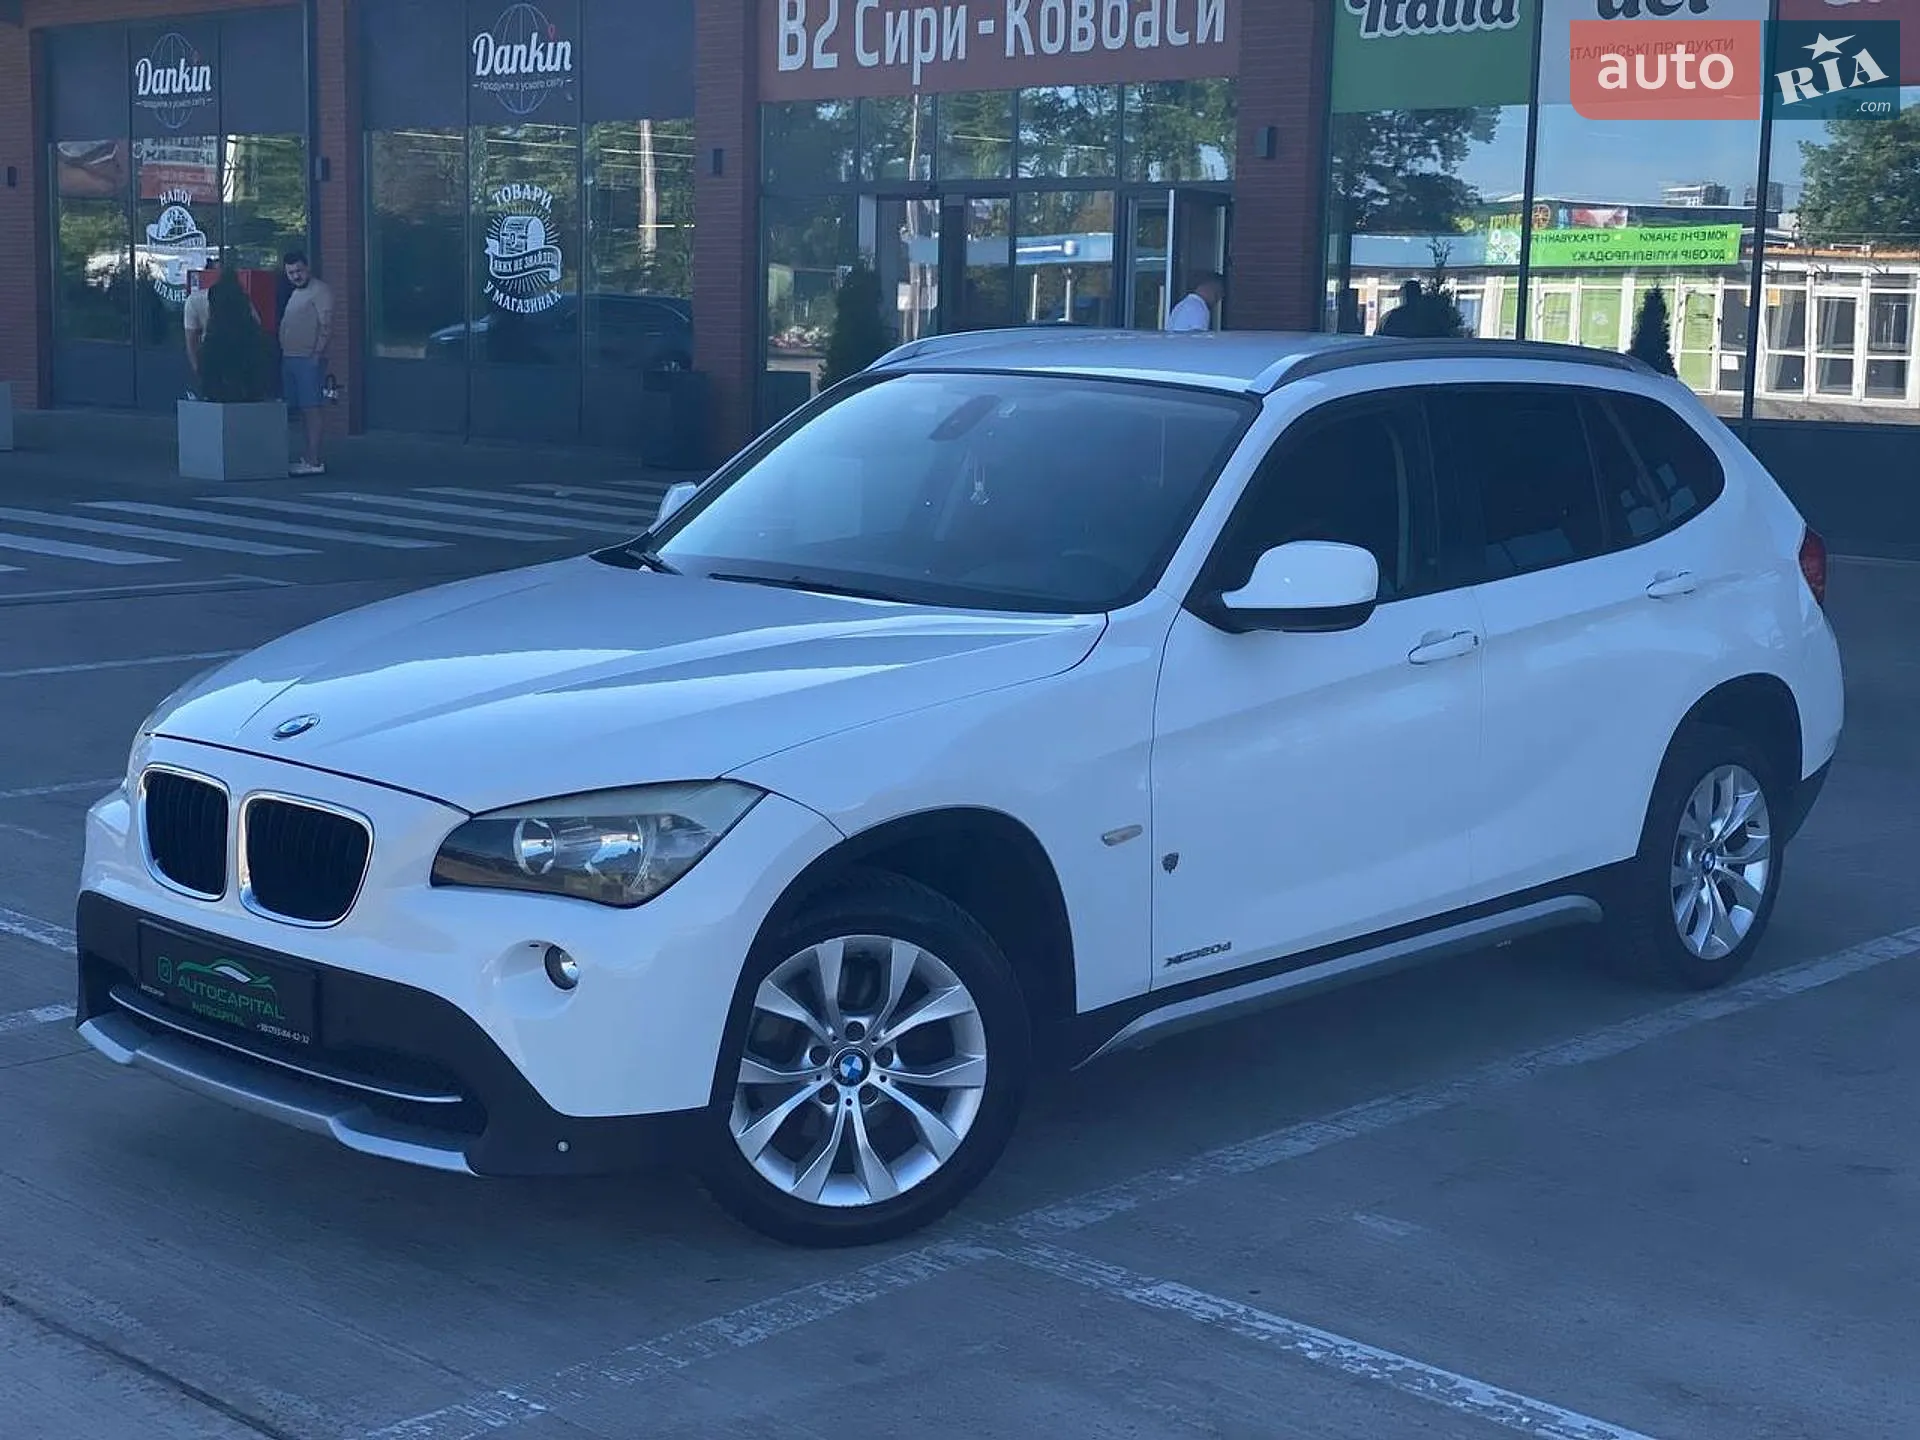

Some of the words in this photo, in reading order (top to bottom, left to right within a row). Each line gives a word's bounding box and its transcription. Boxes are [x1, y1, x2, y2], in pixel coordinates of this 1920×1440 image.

[473, 31, 572, 76] Dankin
[135, 58, 211, 95] Dankin
[176, 973, 286, 1020] AUTOCAPITAL
